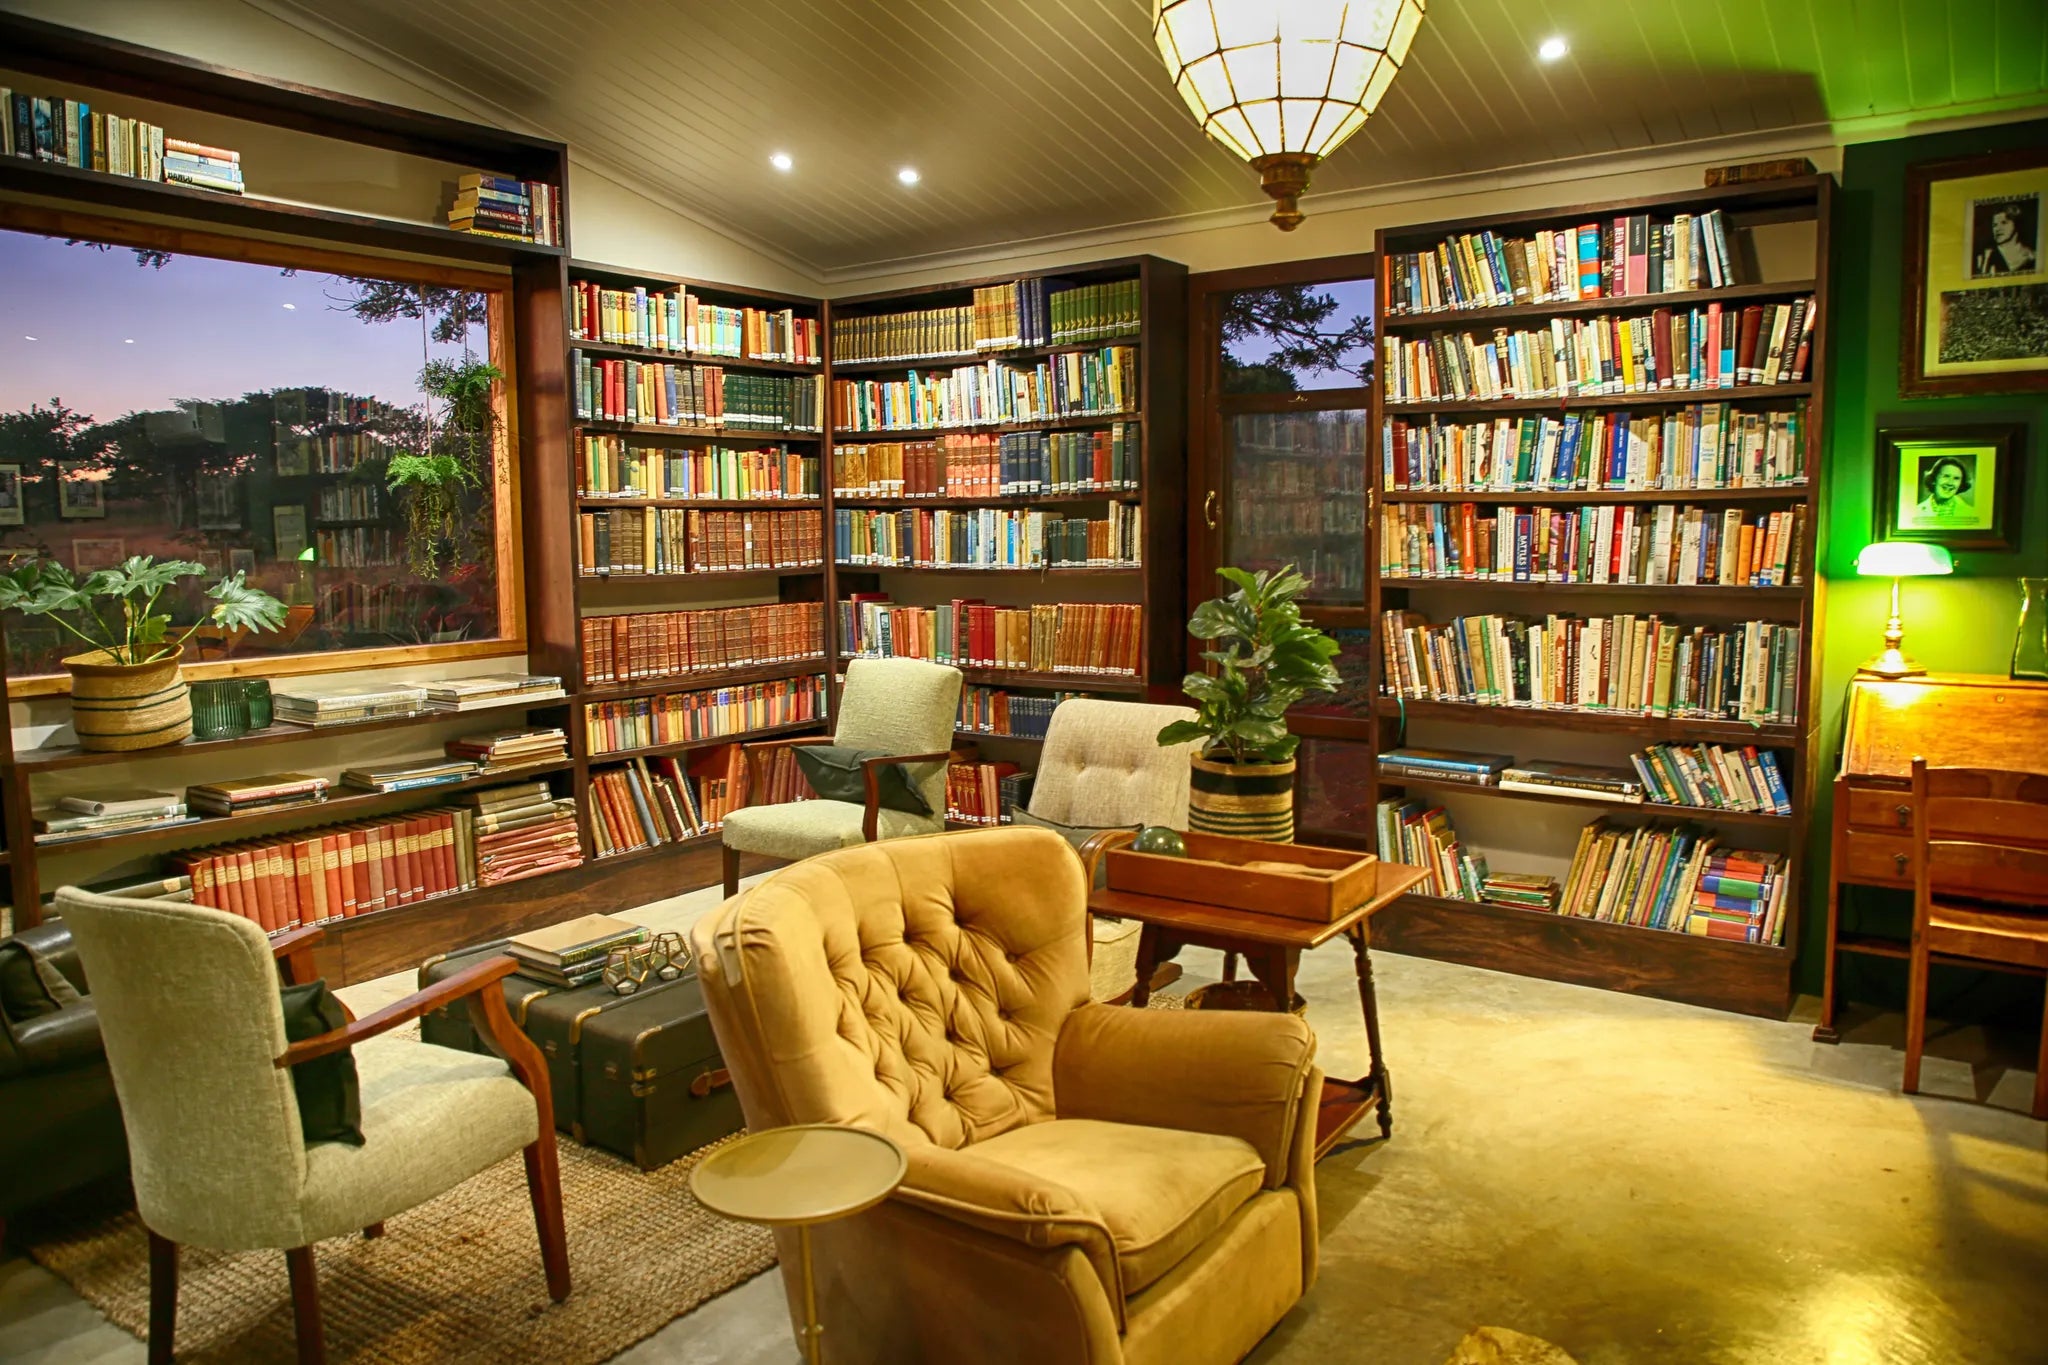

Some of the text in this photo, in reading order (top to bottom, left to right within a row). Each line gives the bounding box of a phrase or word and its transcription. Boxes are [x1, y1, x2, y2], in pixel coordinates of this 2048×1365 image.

[1783, 305, 1804, 370] BRITAIN AT WAR
[1519, 535, 1528, 566] BATTLES
[1758, 662, 1766, 684] BIRDS
[1784, 650, 1796, 689] SAFARI
[1407, 768, 1471, 781] BRITANNICA ATLAS
